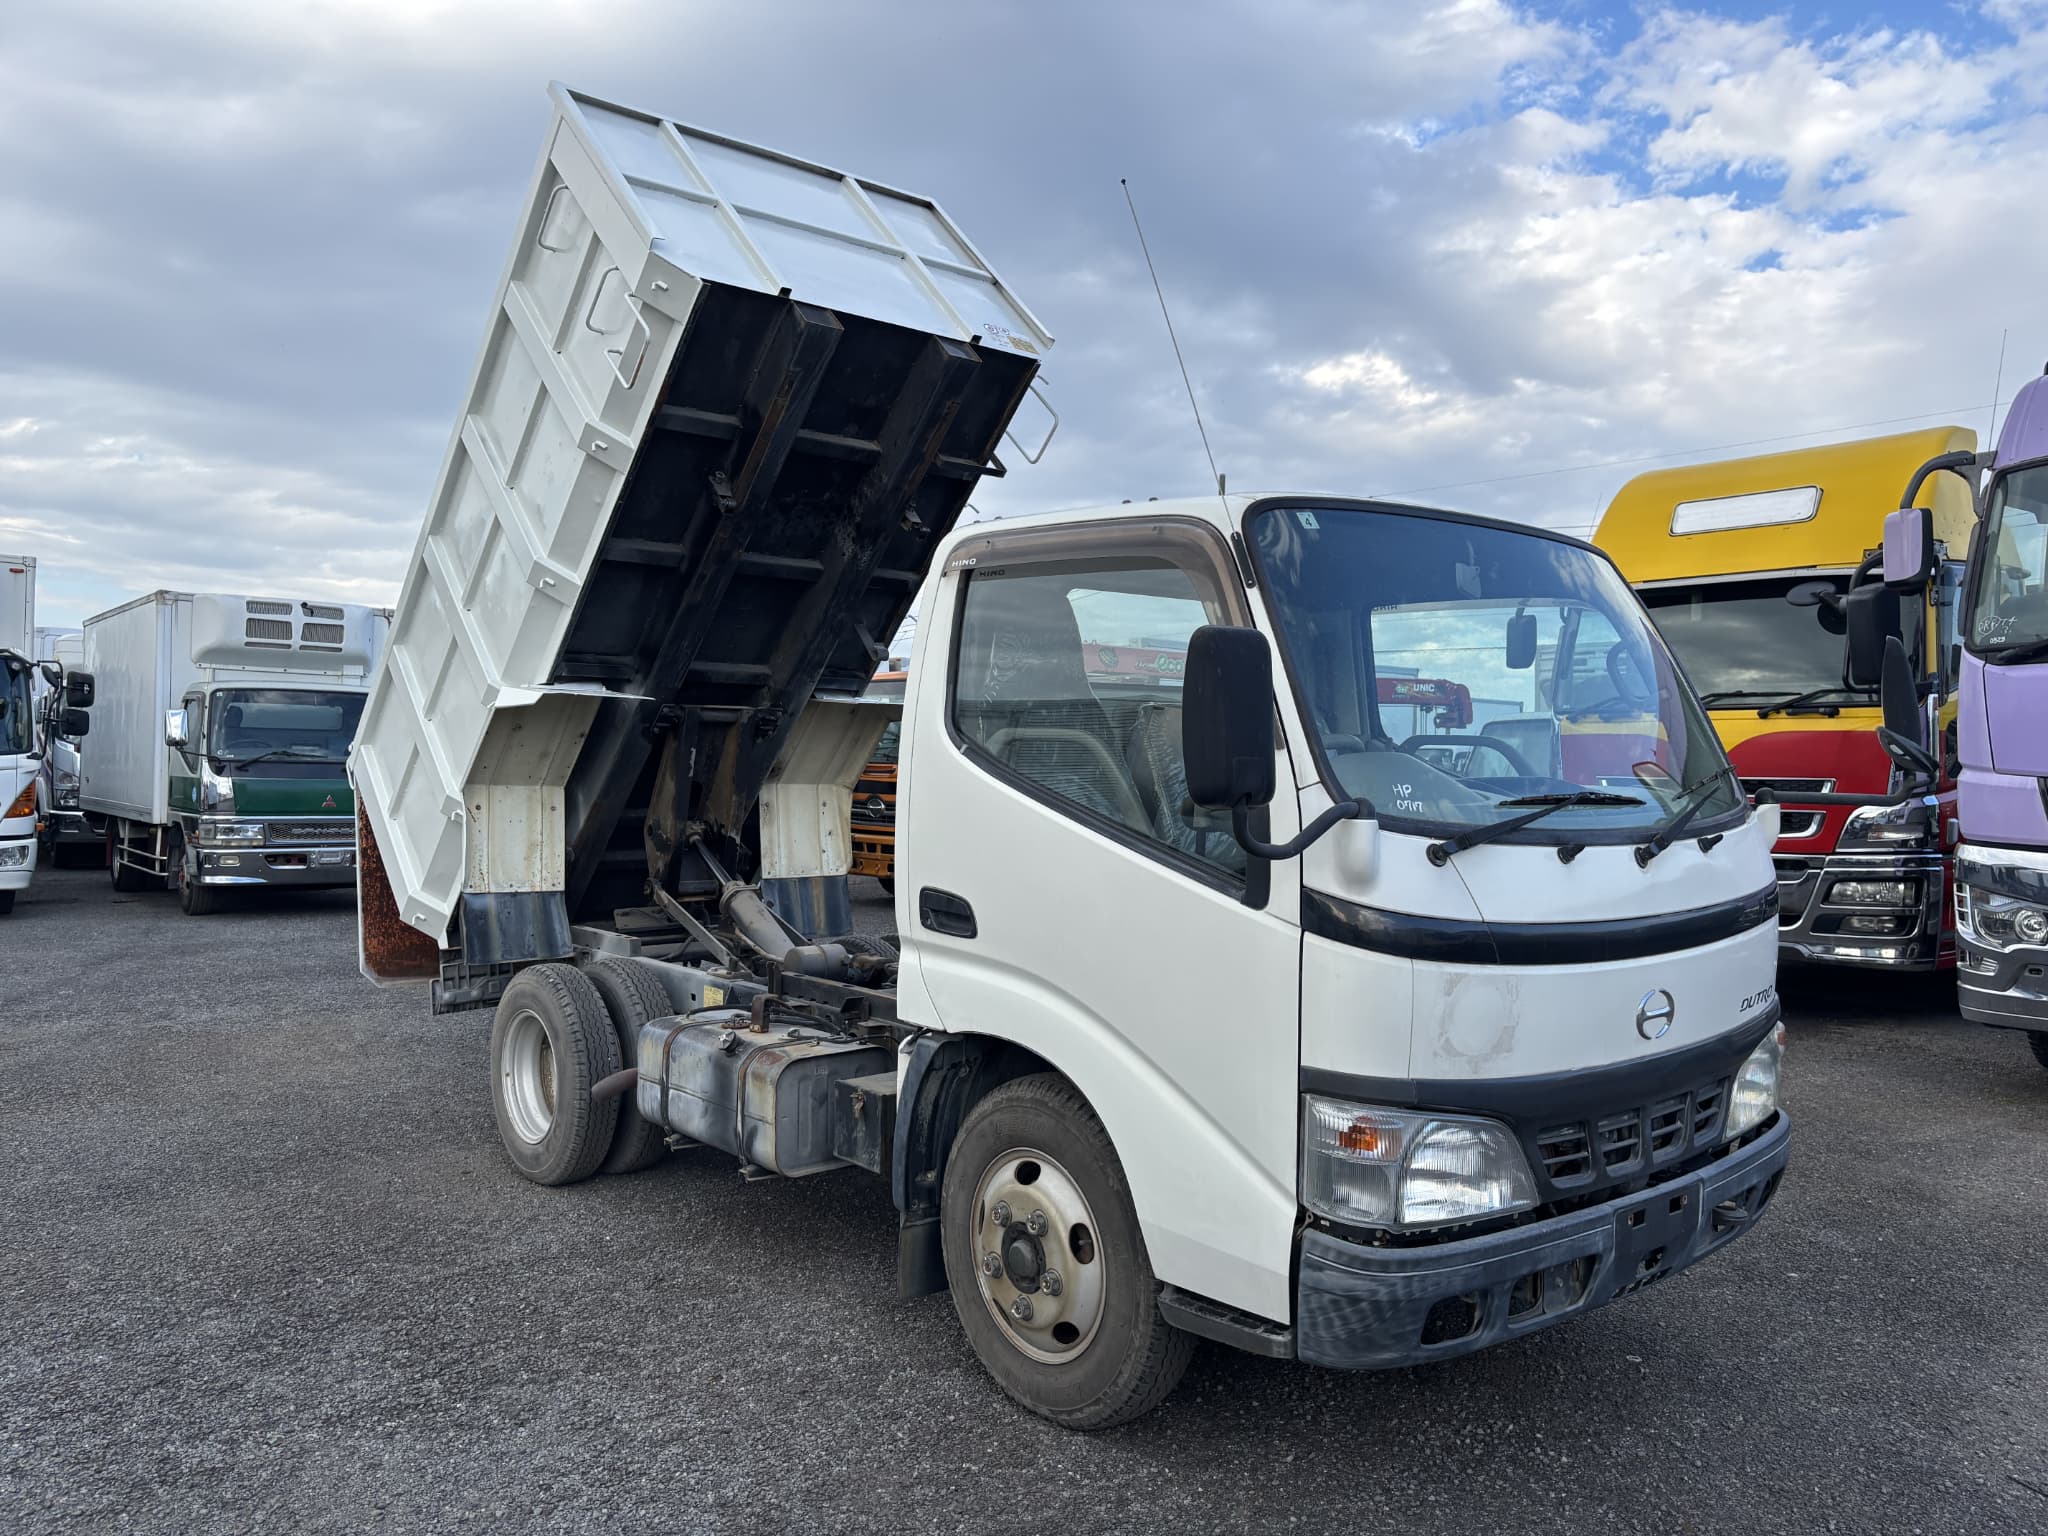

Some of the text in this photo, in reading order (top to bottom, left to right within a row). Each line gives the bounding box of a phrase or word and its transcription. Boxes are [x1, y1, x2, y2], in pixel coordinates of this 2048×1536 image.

[951, 558, 977, 567] HINO
[979, 569, 1006, 577] HINO
[1413, 683, 1435, 692] UNIC
[1391, 783, 1412, 798] HP
[1396, 799, 1423, 813] 0717
[1739, 984, 1773, 1013] DUTRO
